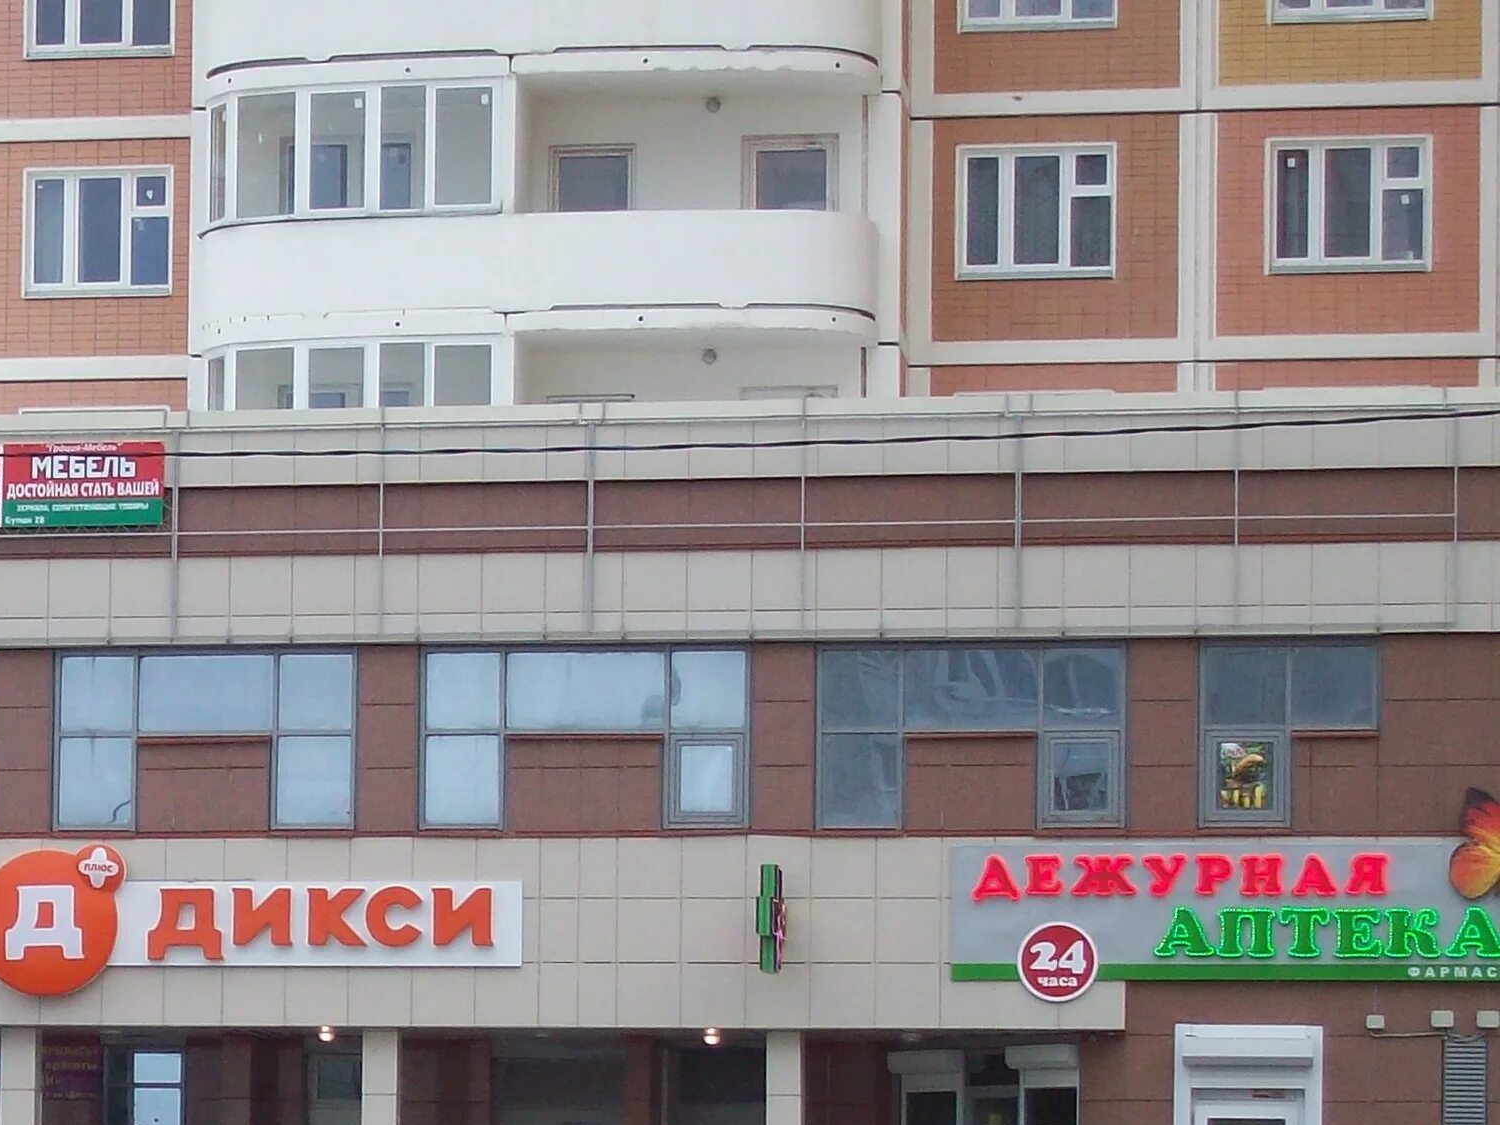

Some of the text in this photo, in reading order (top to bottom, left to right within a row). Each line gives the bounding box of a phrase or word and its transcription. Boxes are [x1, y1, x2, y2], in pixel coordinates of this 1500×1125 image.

[32, 456, 136, 479] МЕБЕЛЬ
[7, 478, 159, 500] ДОСТОЙНАЯ СТАТЬ ВАШЕЙ
[971, 852, 1391, 902] ДЕЖУРНАЯ
[4, 885, 84, 960] Д
[147, 886, 494, 960] ДИКСИ
[1153, 905, 1500, 959] АПТЕКА
[1030, 941, 1086, 974] 24
[1407, 966, 1498, 978] ФАРМАС
[1037, 976, 1078, 988] часа
